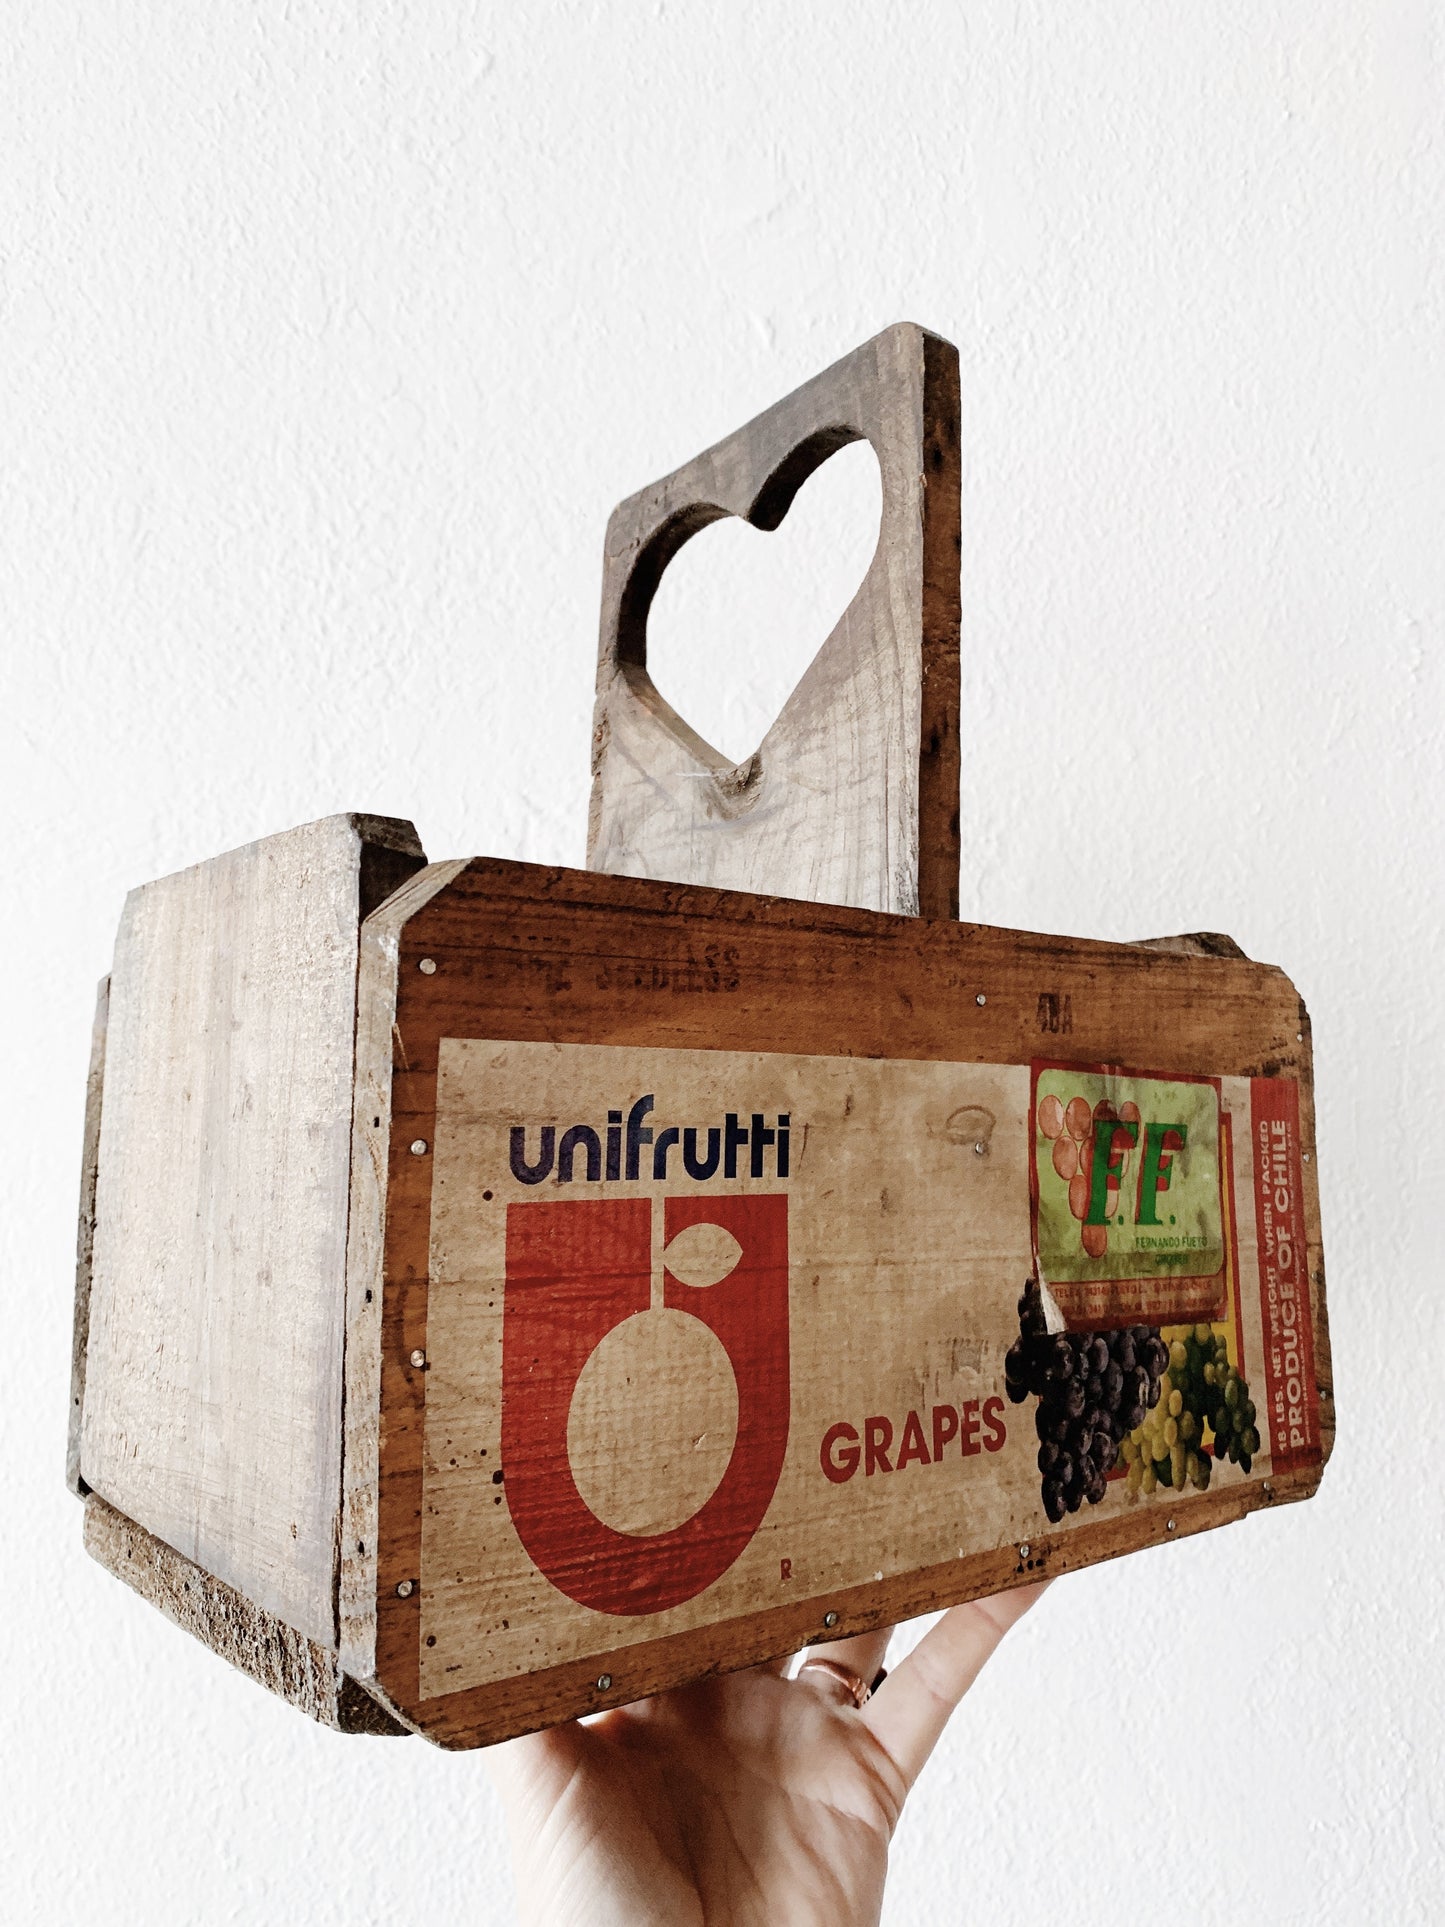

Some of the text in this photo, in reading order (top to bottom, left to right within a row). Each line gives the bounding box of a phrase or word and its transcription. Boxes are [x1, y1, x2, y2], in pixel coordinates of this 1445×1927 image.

[509, 1093, 791, 1186] unifrutti
[1271, 1120, 1289, 1213] CHILE
[1135, 1236, 1180, 1249] FERNANDO
[1260, 1120, 1287, 1451] 18 LBS. NET WEIGHT WHEN PACKED
[1276, 1226, 1292, 1270] OF
[1279, 1282, 1304, 1448] PRODUCE
[820, 1396, 1007, 1484] GRAPES
[780, 1558, 792, 1580] R
